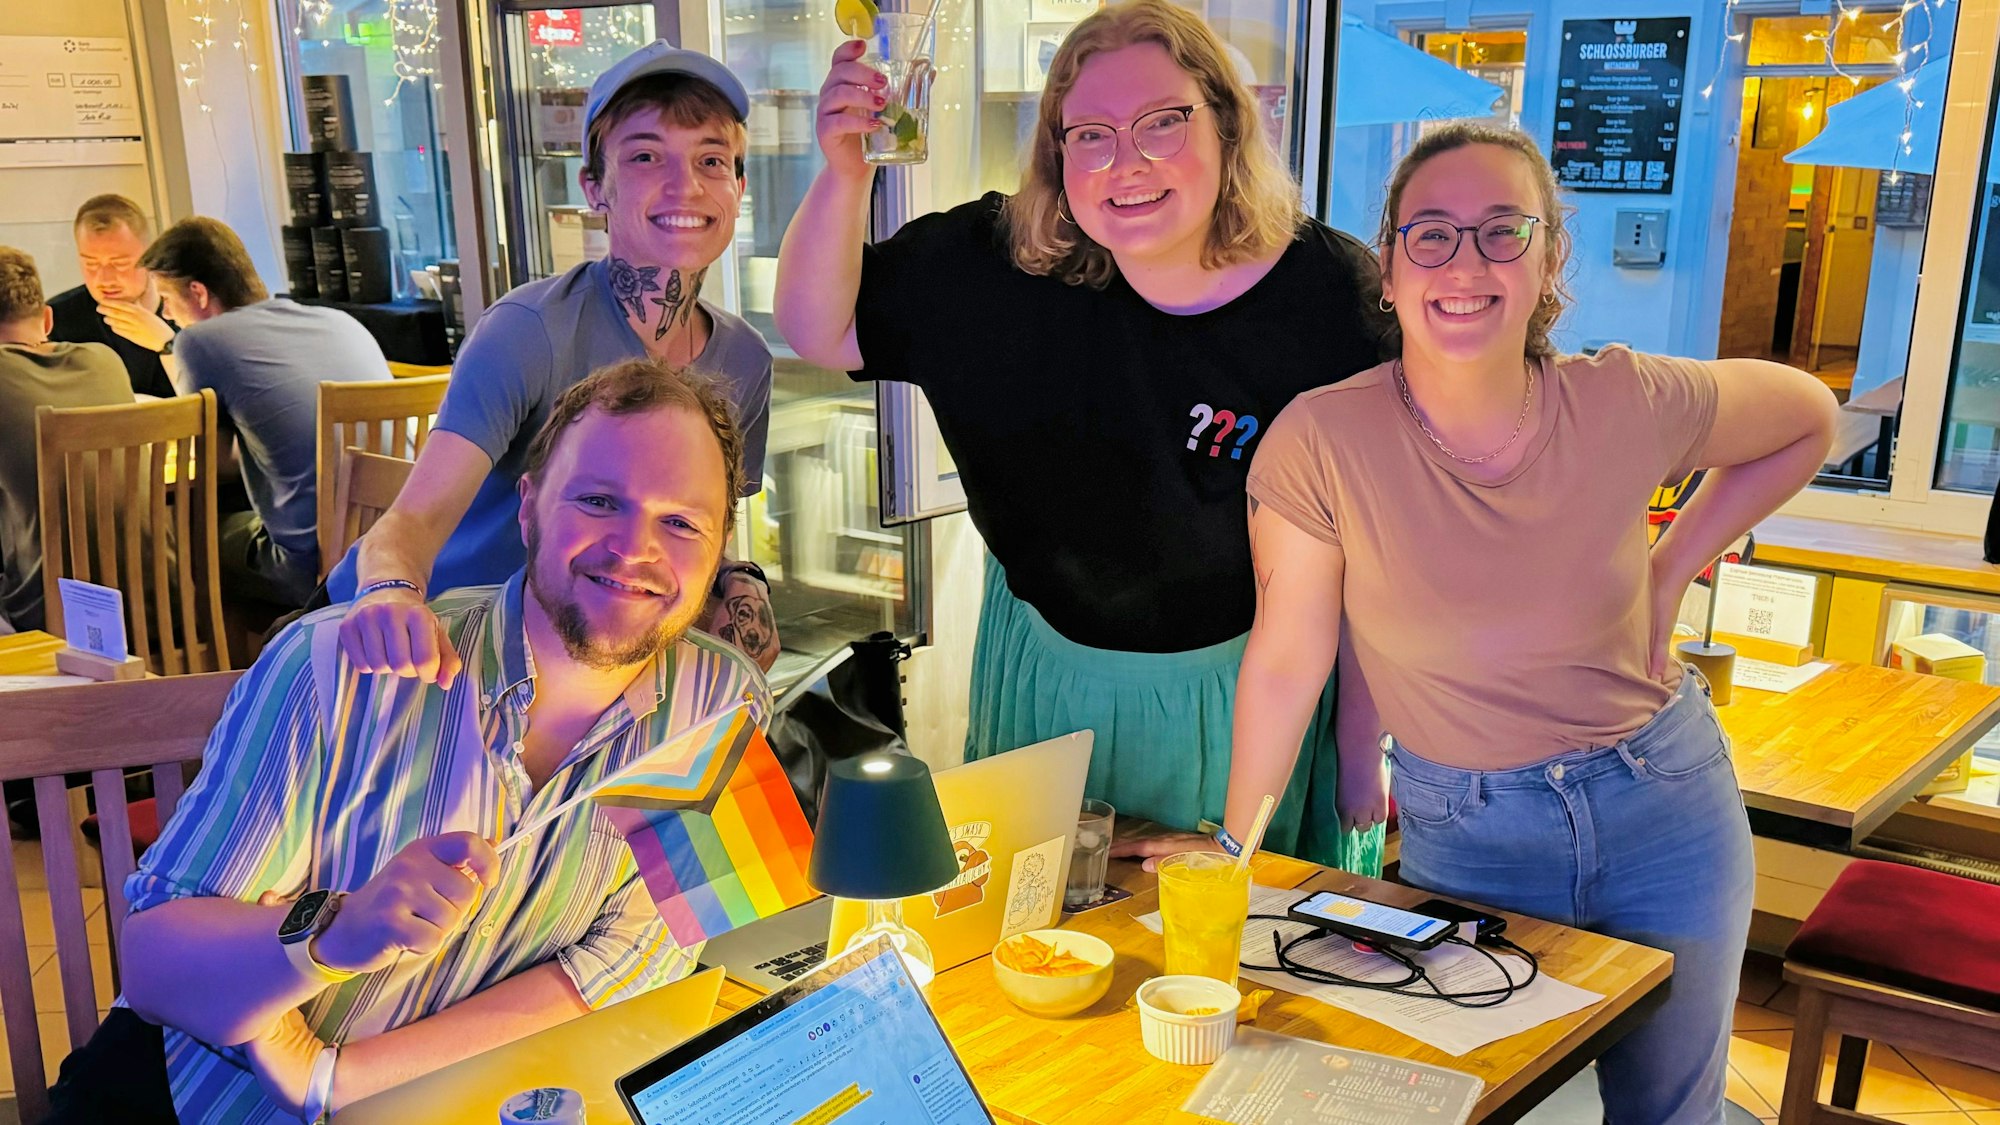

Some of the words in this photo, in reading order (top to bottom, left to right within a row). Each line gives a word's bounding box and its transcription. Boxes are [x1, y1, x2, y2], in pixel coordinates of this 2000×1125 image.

[1580, 43, 1667, 60] SCHLOSSBURGER
[662, 1112, 675, 1123] Pride
[686, 1093, 708, 1109] Selbstbild
[713, 1074, 740, 1094] Forderungen
